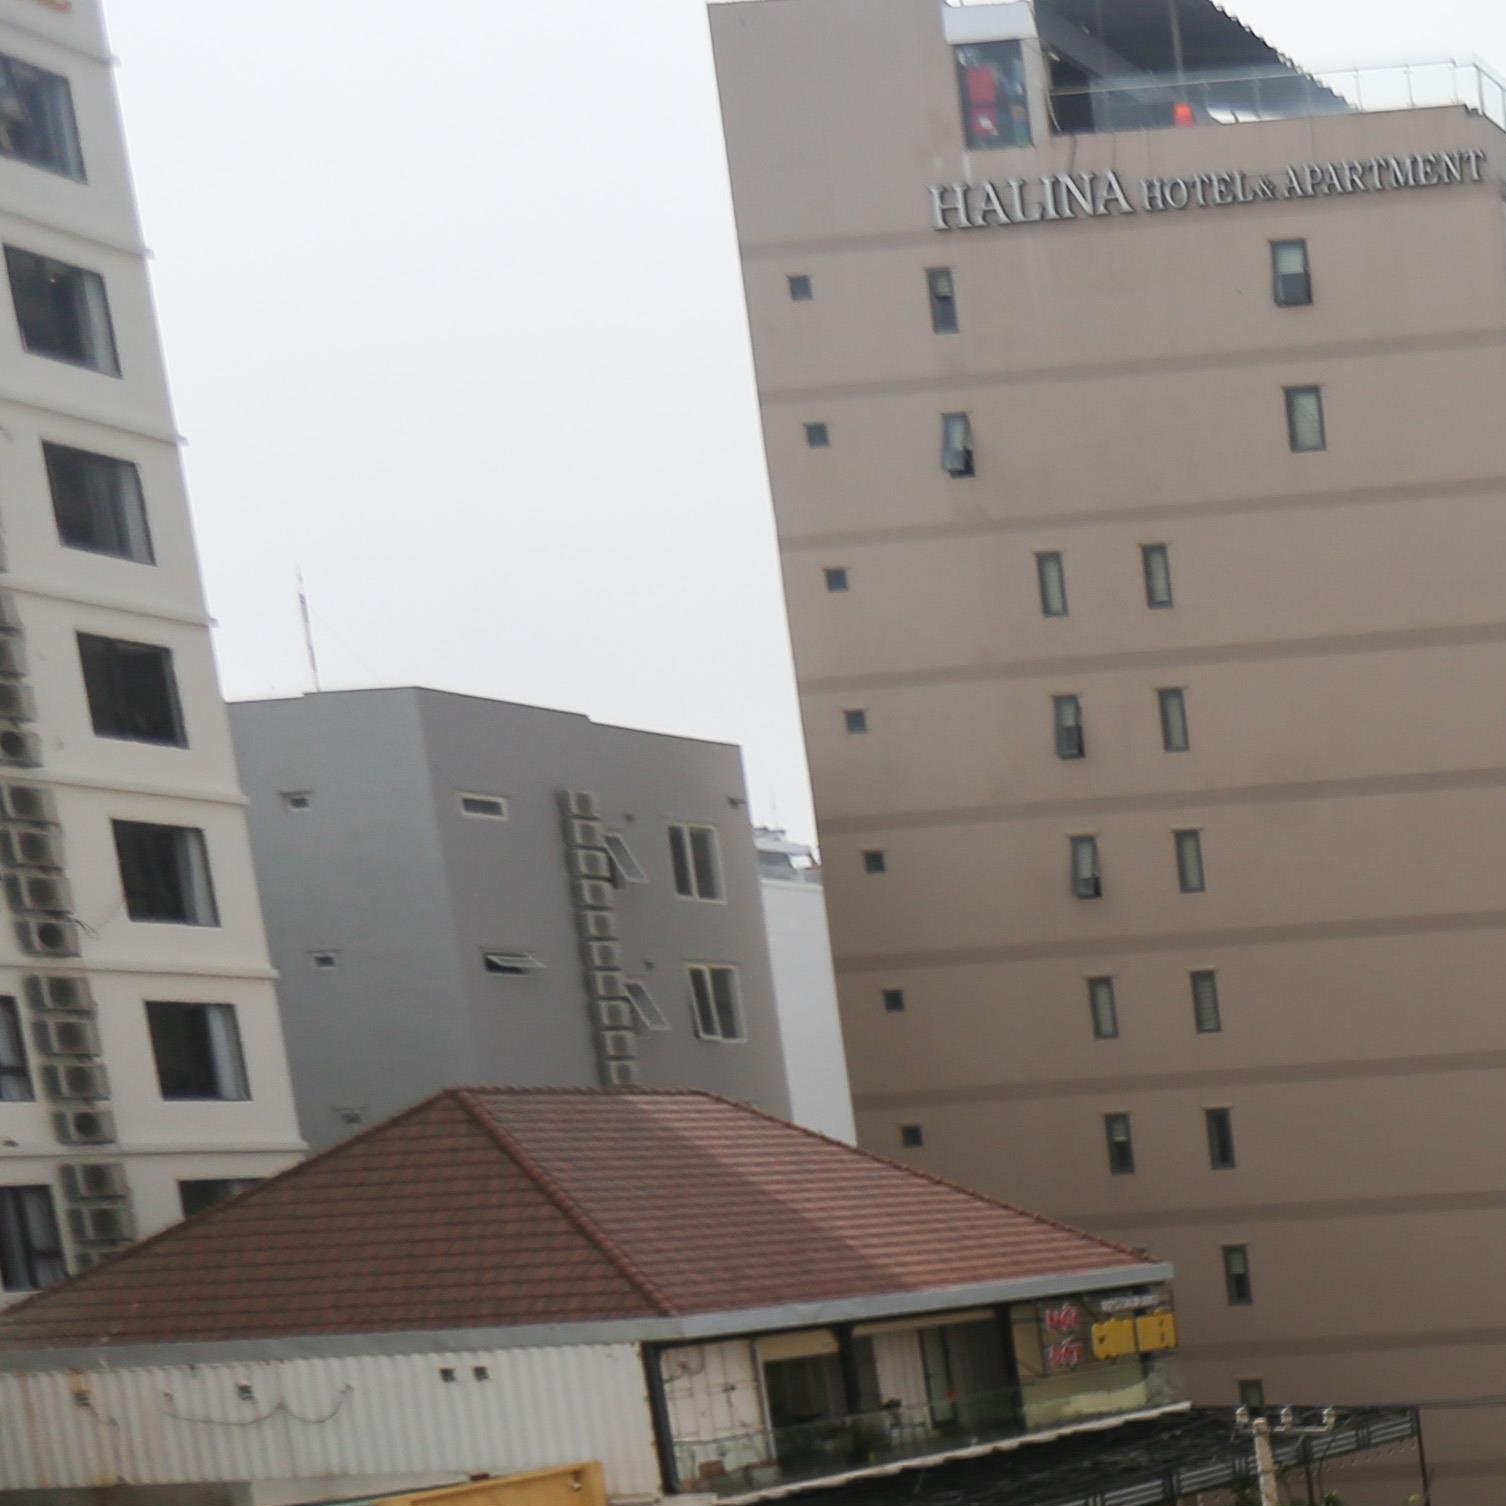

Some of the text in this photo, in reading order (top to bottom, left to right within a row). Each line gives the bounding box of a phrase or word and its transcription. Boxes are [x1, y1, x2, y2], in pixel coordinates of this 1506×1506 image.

[928, 148, 1487, 231] HALINA HOTEL & APARTMENT
